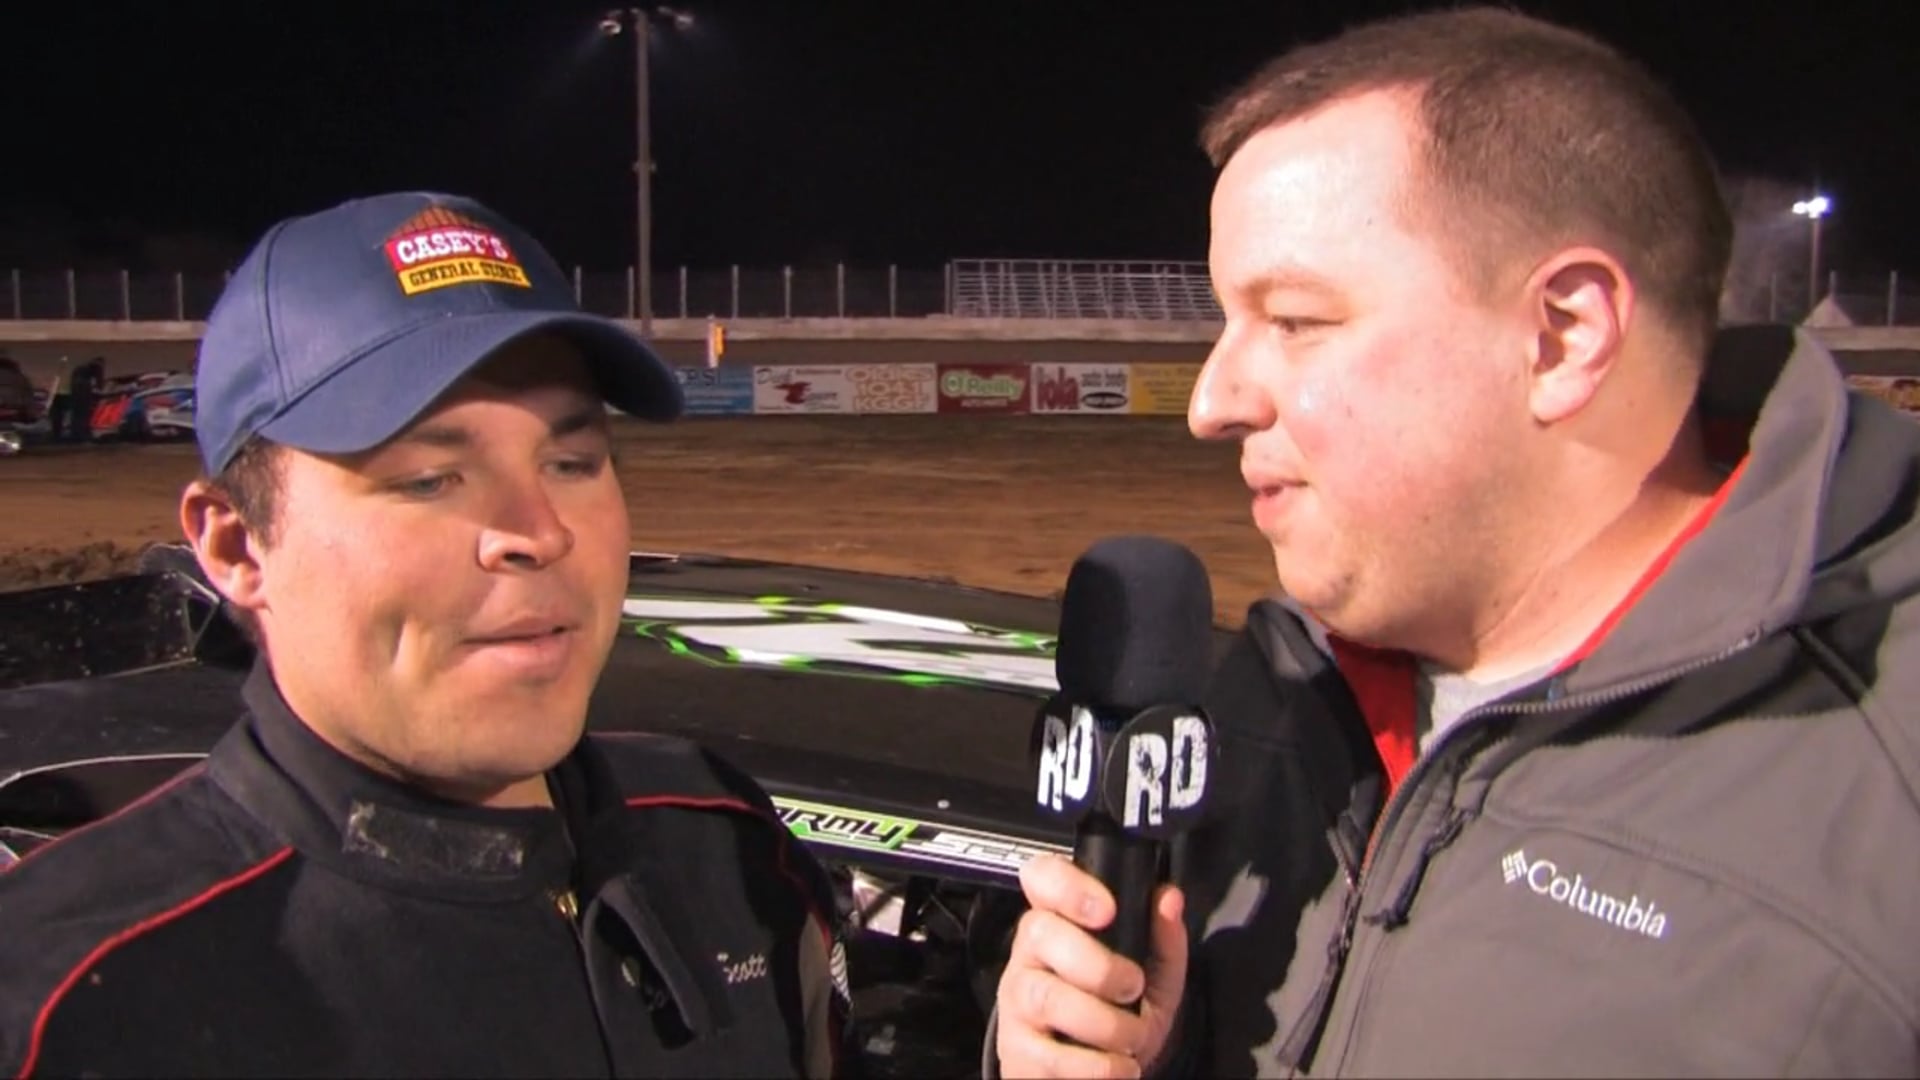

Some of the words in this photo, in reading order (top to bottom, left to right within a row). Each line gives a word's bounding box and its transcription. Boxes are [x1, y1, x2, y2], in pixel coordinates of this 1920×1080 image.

[397, 231, 508, 263] CASEY'S
[409, 261, 480, 287] GENERAL
[943, 371, 1024, 398] O'Reilly
[1038, 704, 1094, 812] RD
[1124, 716, 1208, 827] RD
[1527, 859, 1667, 939] Columbia
